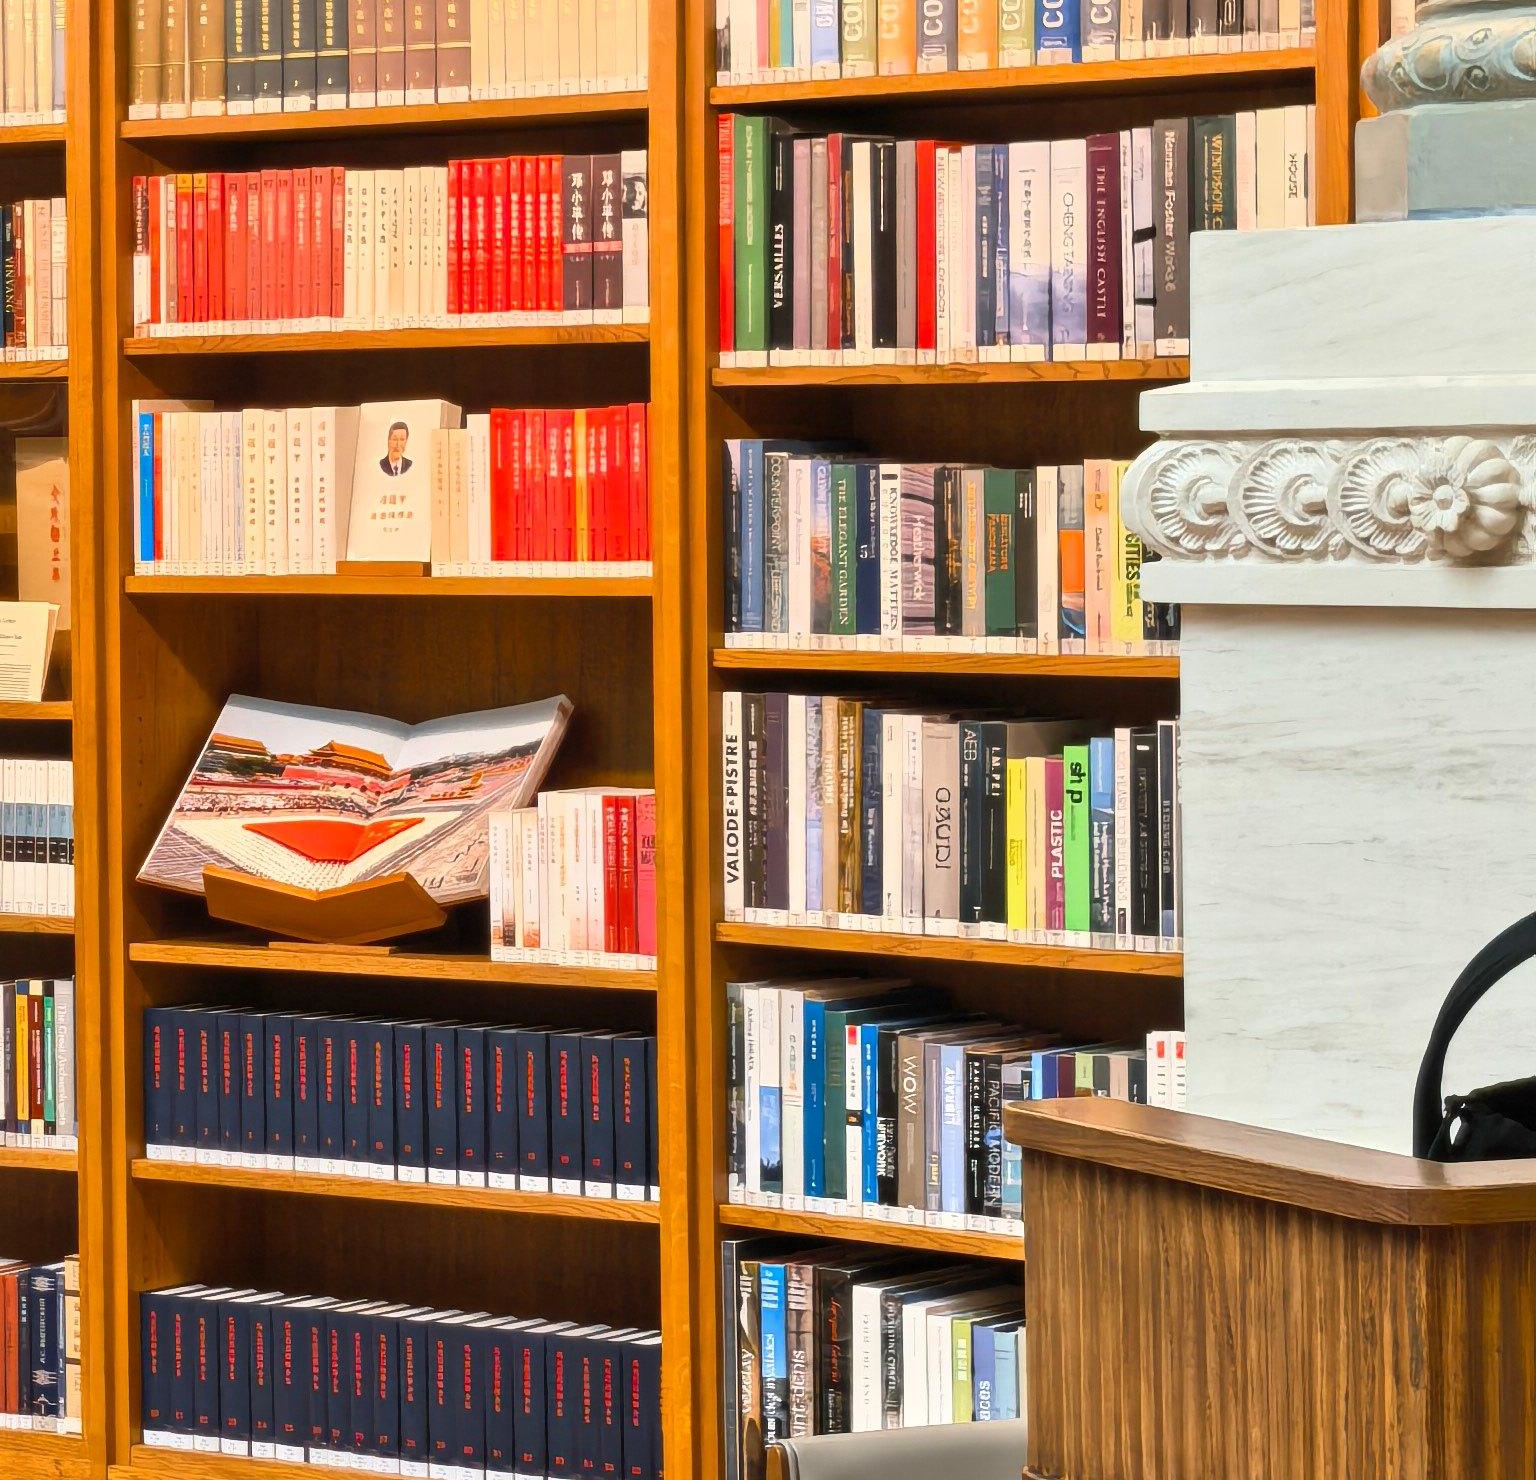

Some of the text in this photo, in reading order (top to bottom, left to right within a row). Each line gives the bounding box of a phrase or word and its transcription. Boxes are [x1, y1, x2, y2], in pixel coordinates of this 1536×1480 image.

[1096, 165, 1106, 319] THE ENGLISH CASTLE
[1164, 190, 1176, 238] Foster
[773, 224, 785, 308] VERSAILLES
[838, 480, 847, 625] THE ELEGANT GARDEN
[912, 515, 926, 601] Heatherwick
[725, 734, 738, 884] VALODE PISTRE
[1050, 810, 1062, 878] PLASTIC
[904, 1056, 918, 1115] WOW
[944, 1067, 956, 1124] LIBRARY
